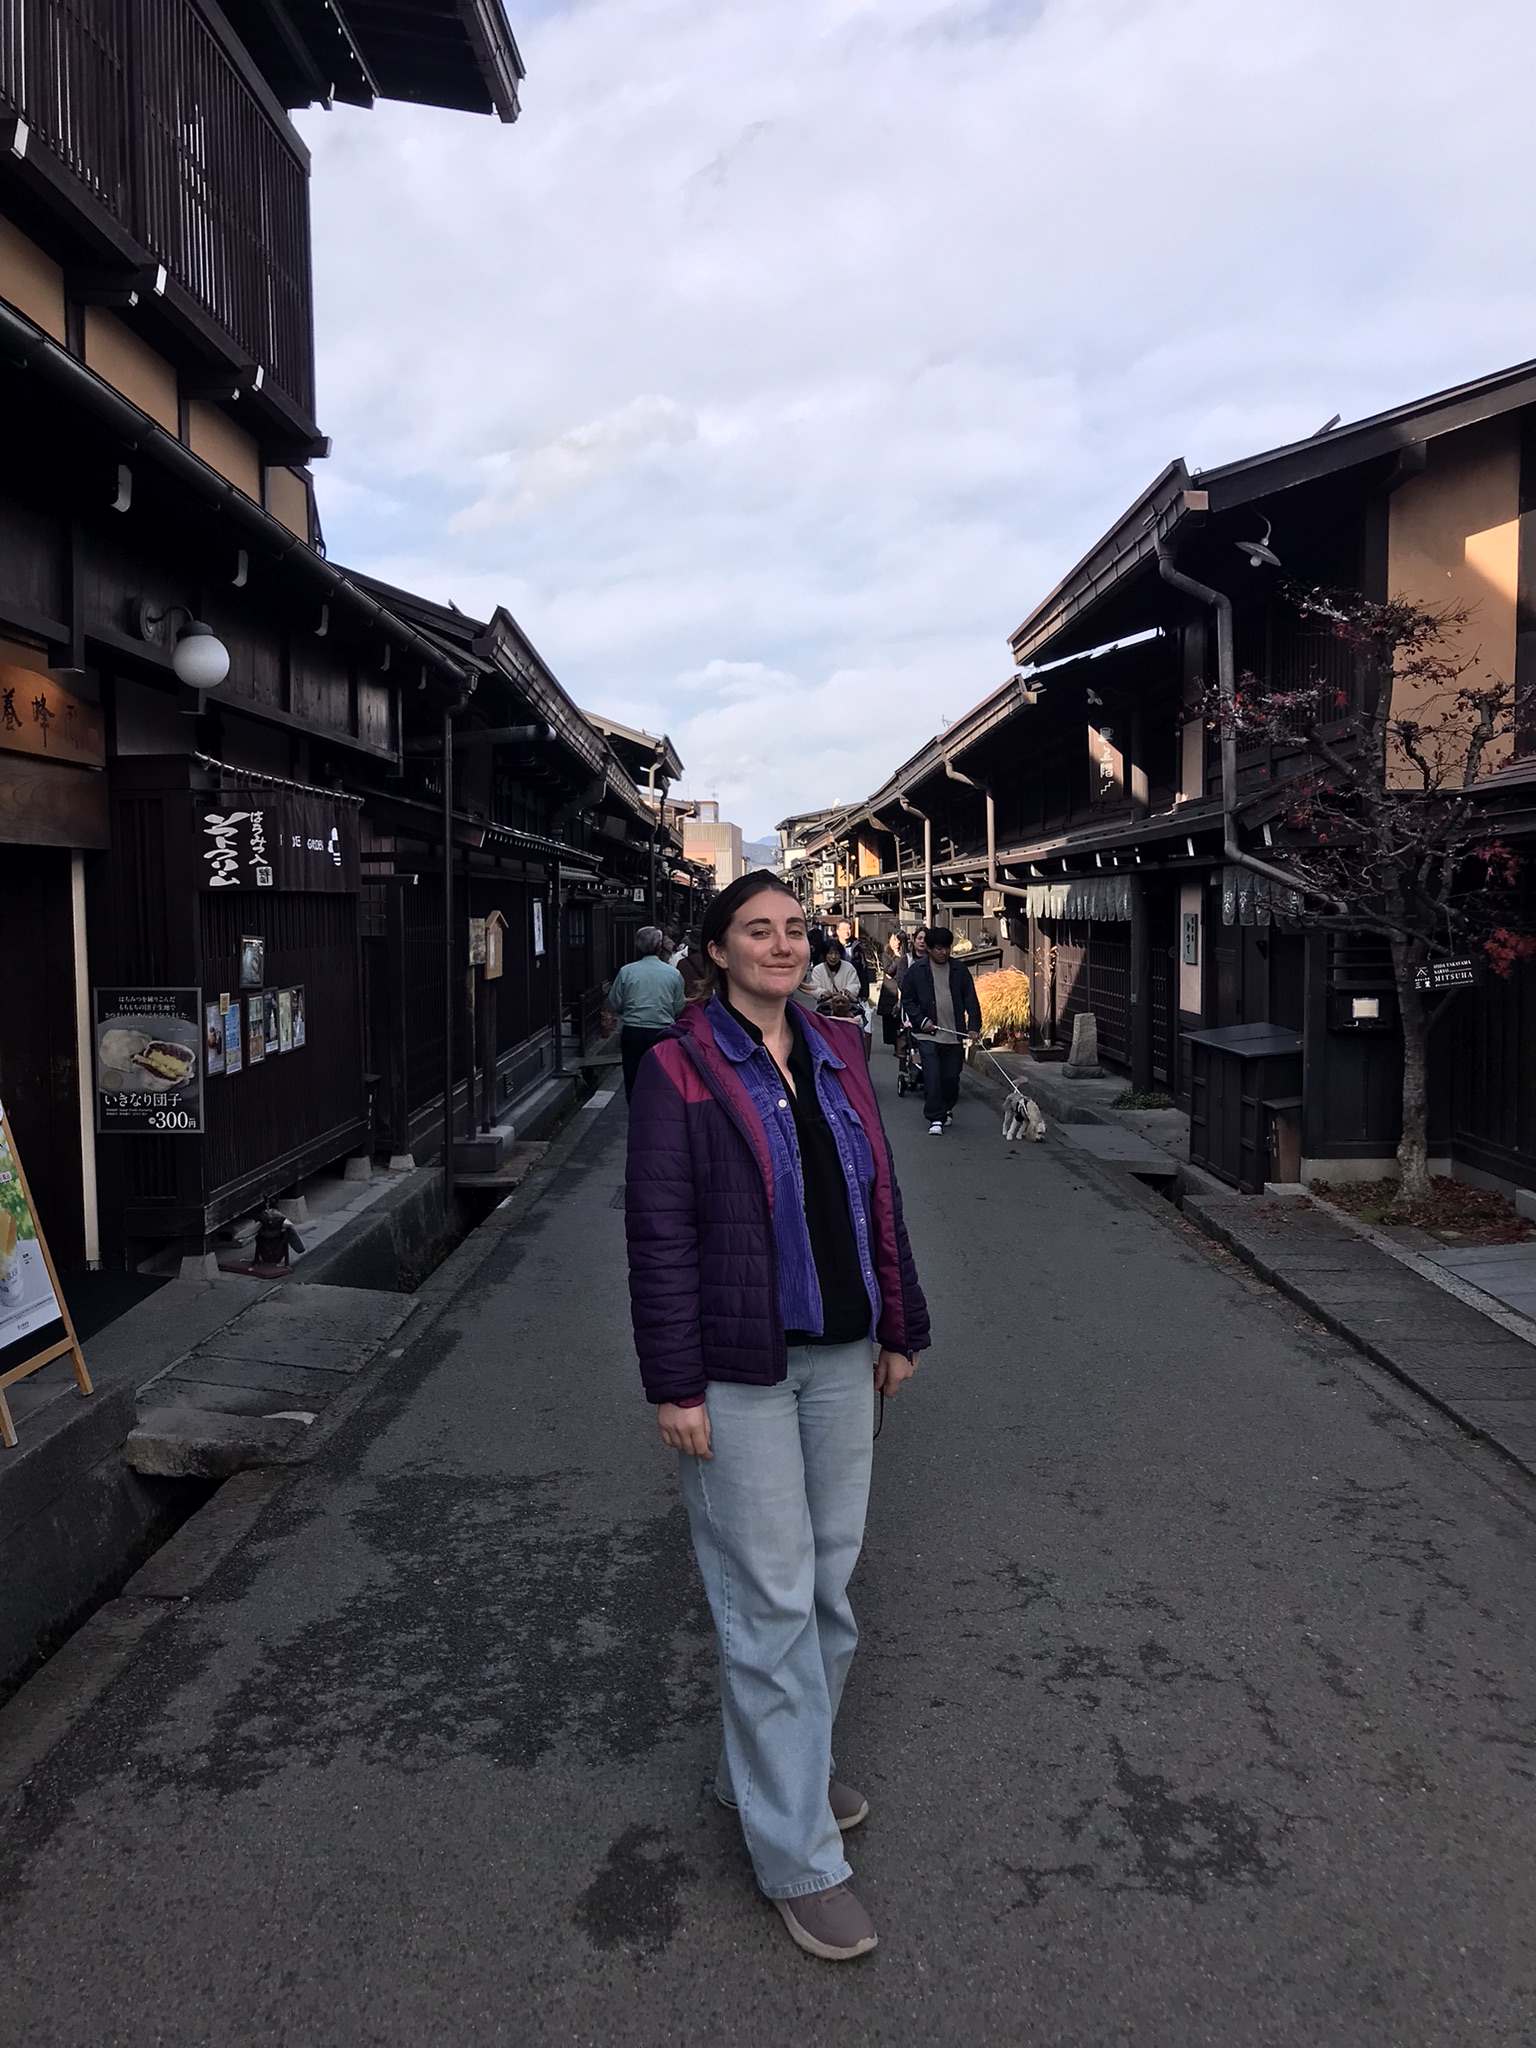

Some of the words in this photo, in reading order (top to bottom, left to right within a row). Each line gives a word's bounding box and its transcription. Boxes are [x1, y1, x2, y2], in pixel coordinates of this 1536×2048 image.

[248, 810, 268, 865] はちみつ入
[1434, 972, 1473, 982] MITSUHA
[104, 1092, 182, 1107] いきなり団子
[155, 1111, 196, 1128] 300円
